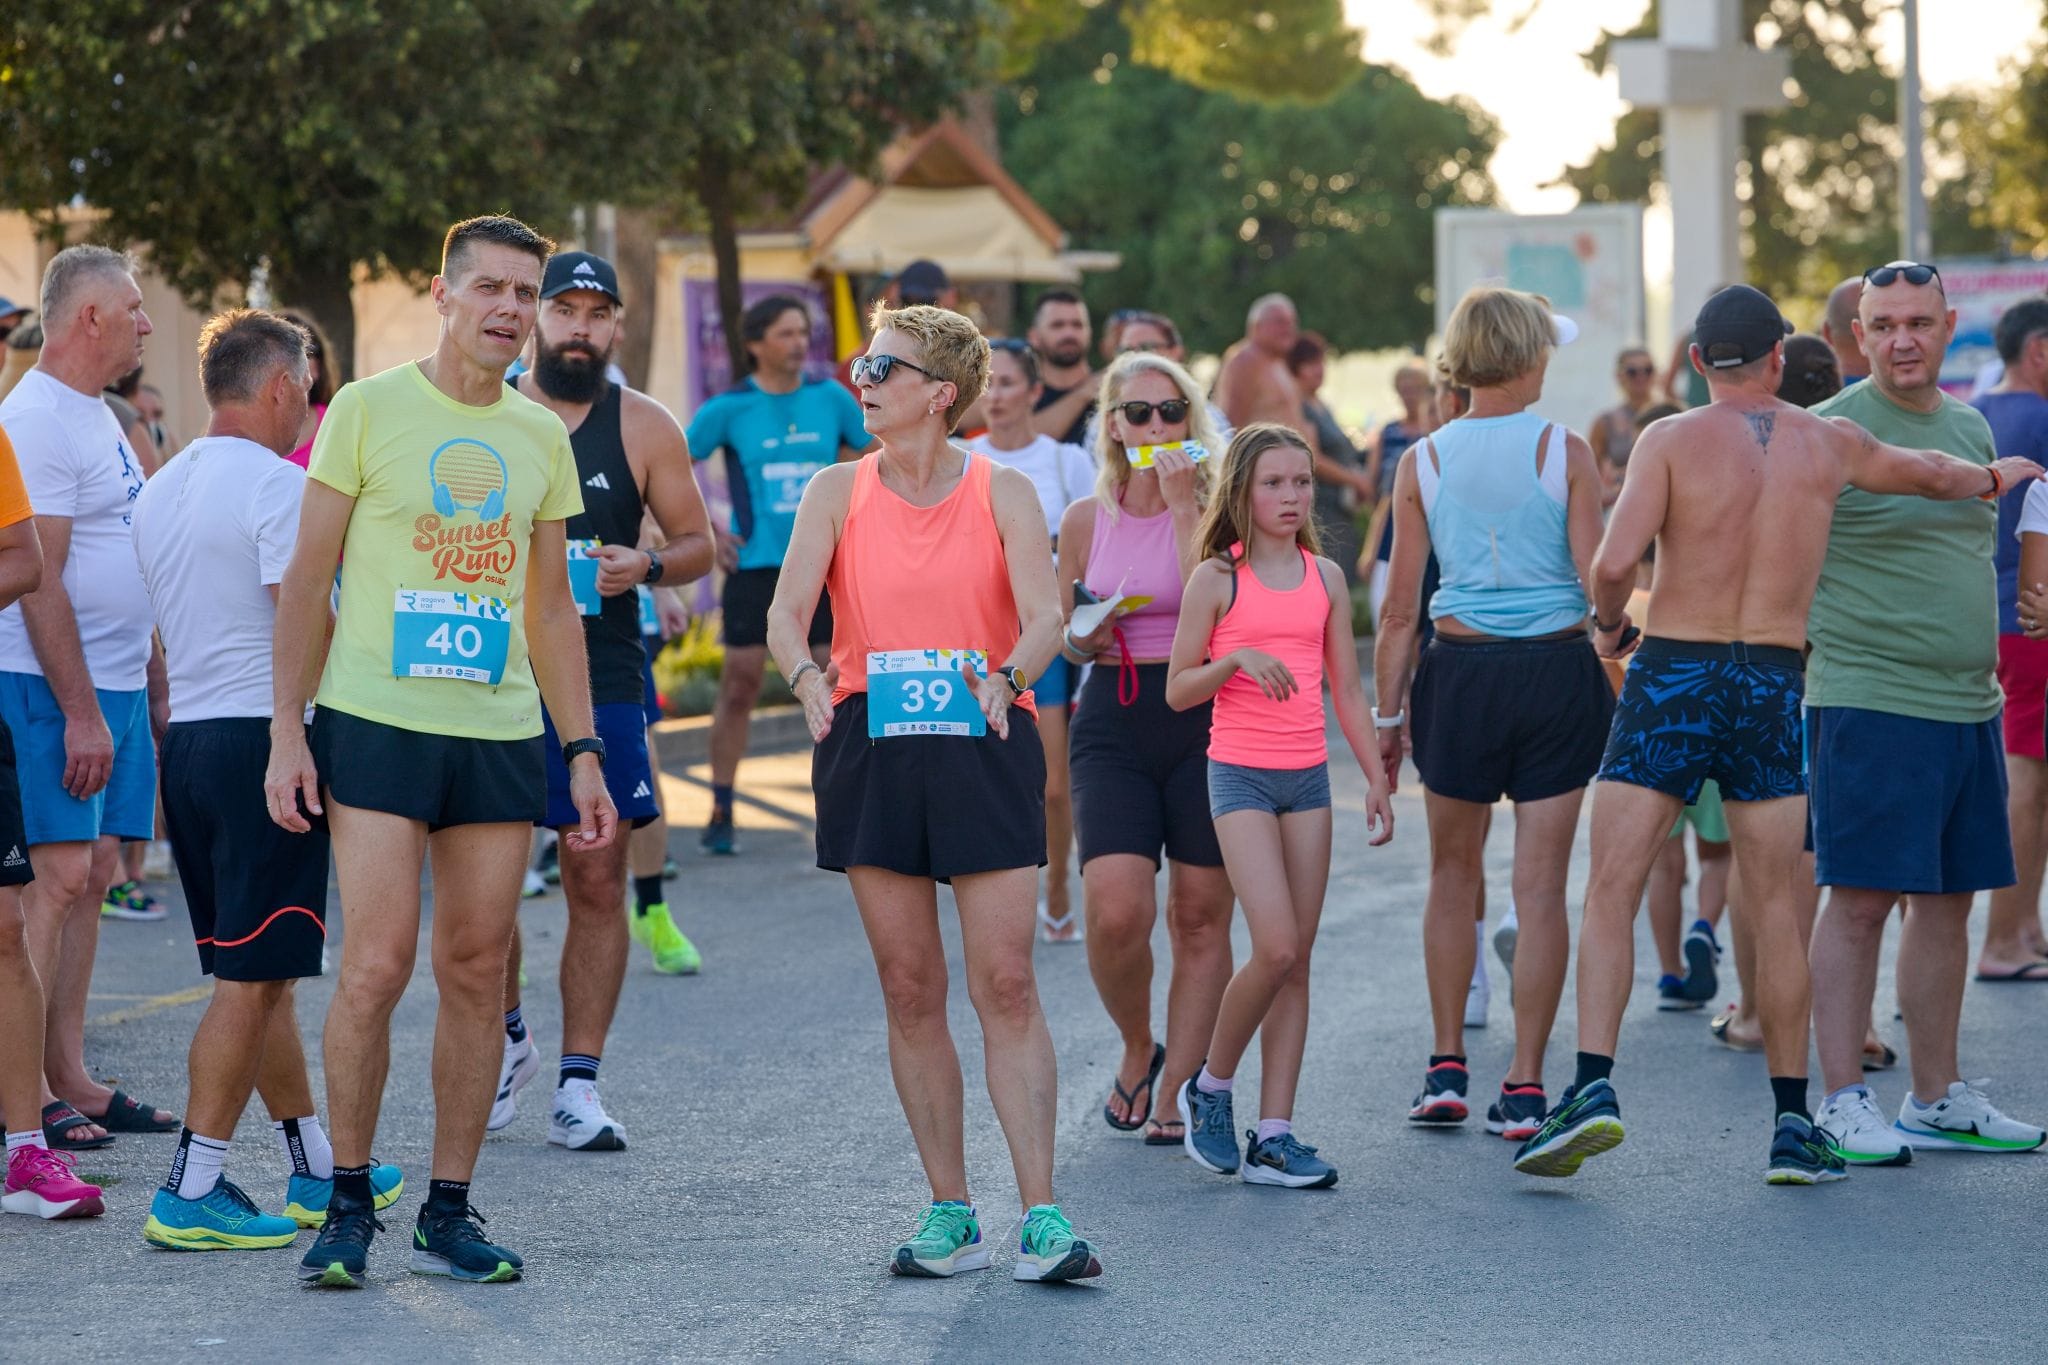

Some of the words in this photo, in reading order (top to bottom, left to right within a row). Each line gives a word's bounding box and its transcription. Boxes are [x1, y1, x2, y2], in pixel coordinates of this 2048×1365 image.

[412, 512, 512, 552] Sunset
[432, 540, 516, 583] Run
[484, 575, 507, 586] OSIJEK
[425, 622, 483, 658] 40
[901, 678, 953, 713] 39
[3, 857, 26, 867] adidas
